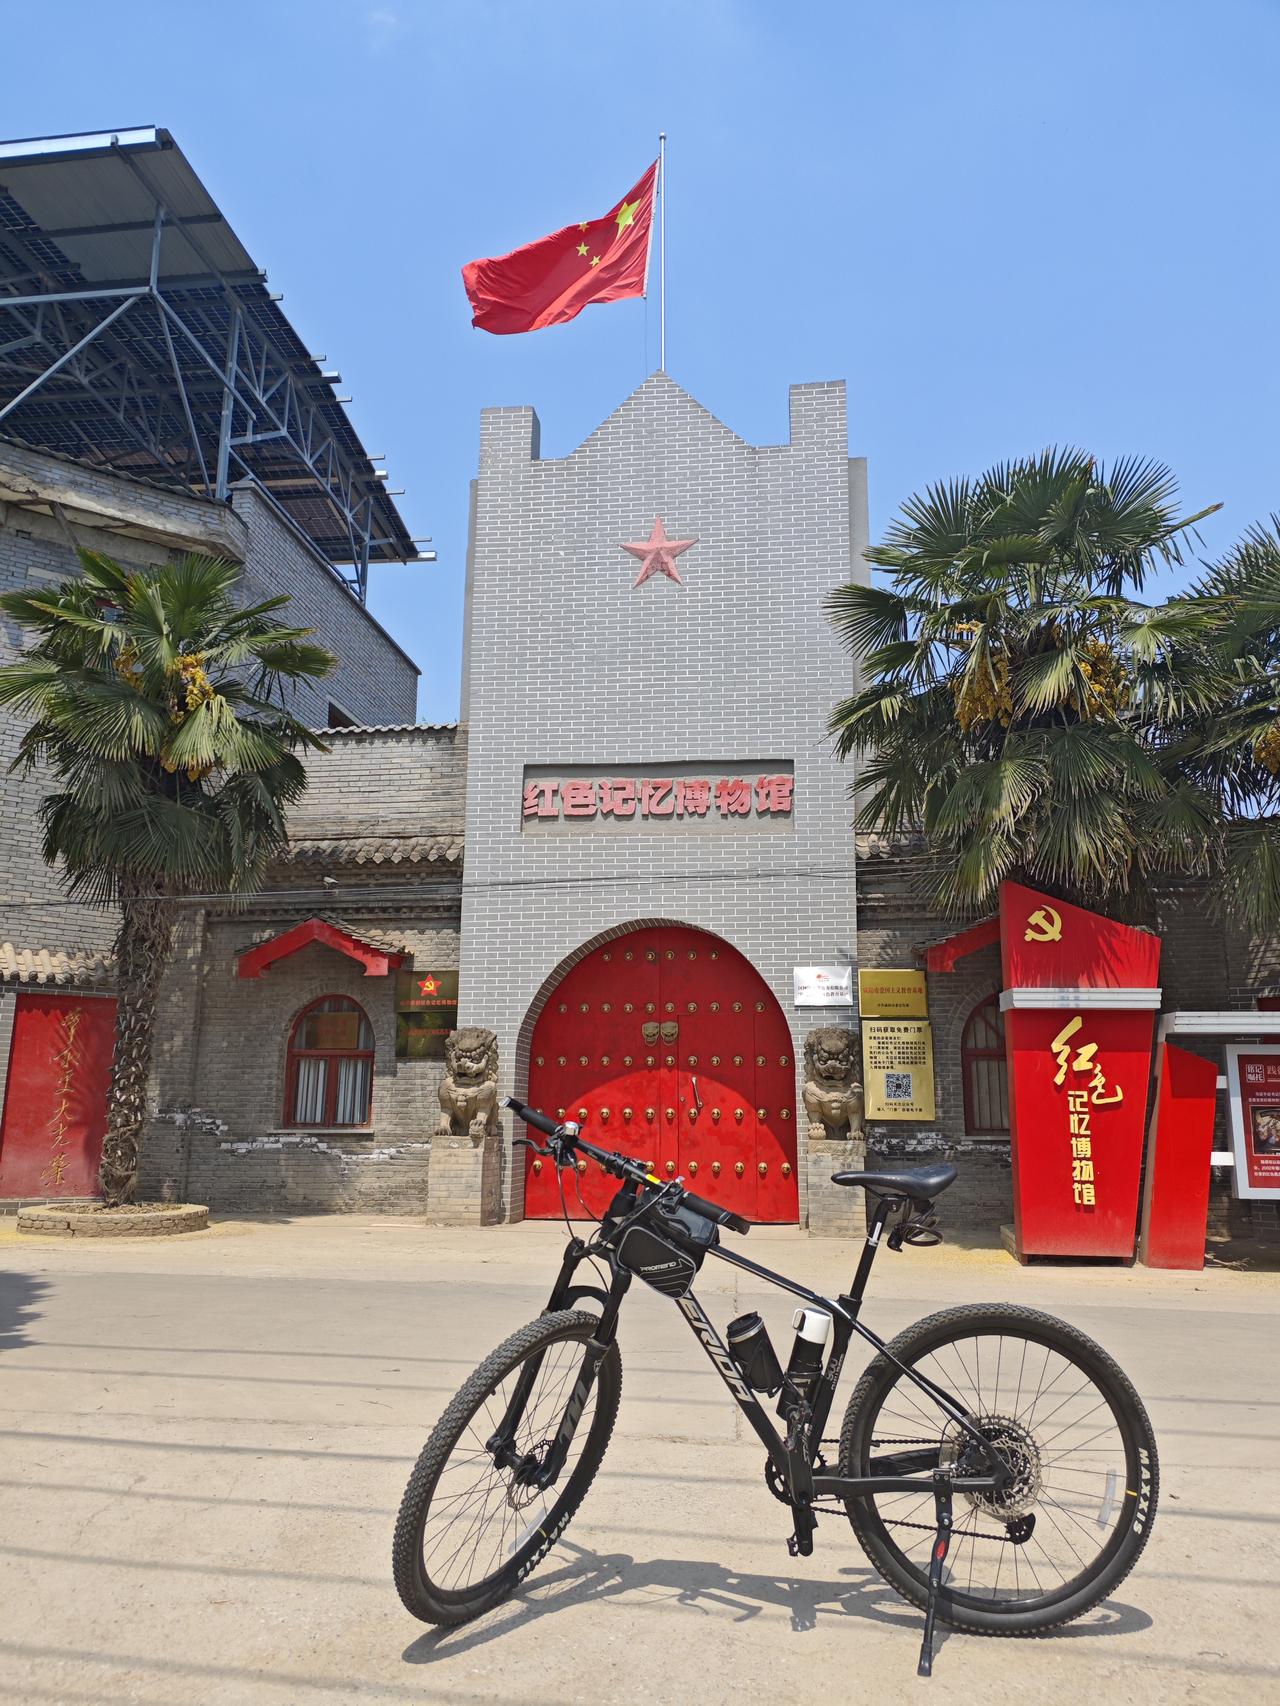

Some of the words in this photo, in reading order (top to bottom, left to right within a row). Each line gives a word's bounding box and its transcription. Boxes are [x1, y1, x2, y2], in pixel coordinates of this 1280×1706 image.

[523, 775, 794, 817] 红色记忆博物馆
[1067, 1090, 1096, 1207] 记忆博物馆
[678, 1290, 757, 1402] ERIDA
[1132, 1447, 1151, 1535] MAXXIS
[517, 1511, 570, 1580] MAXXIS
